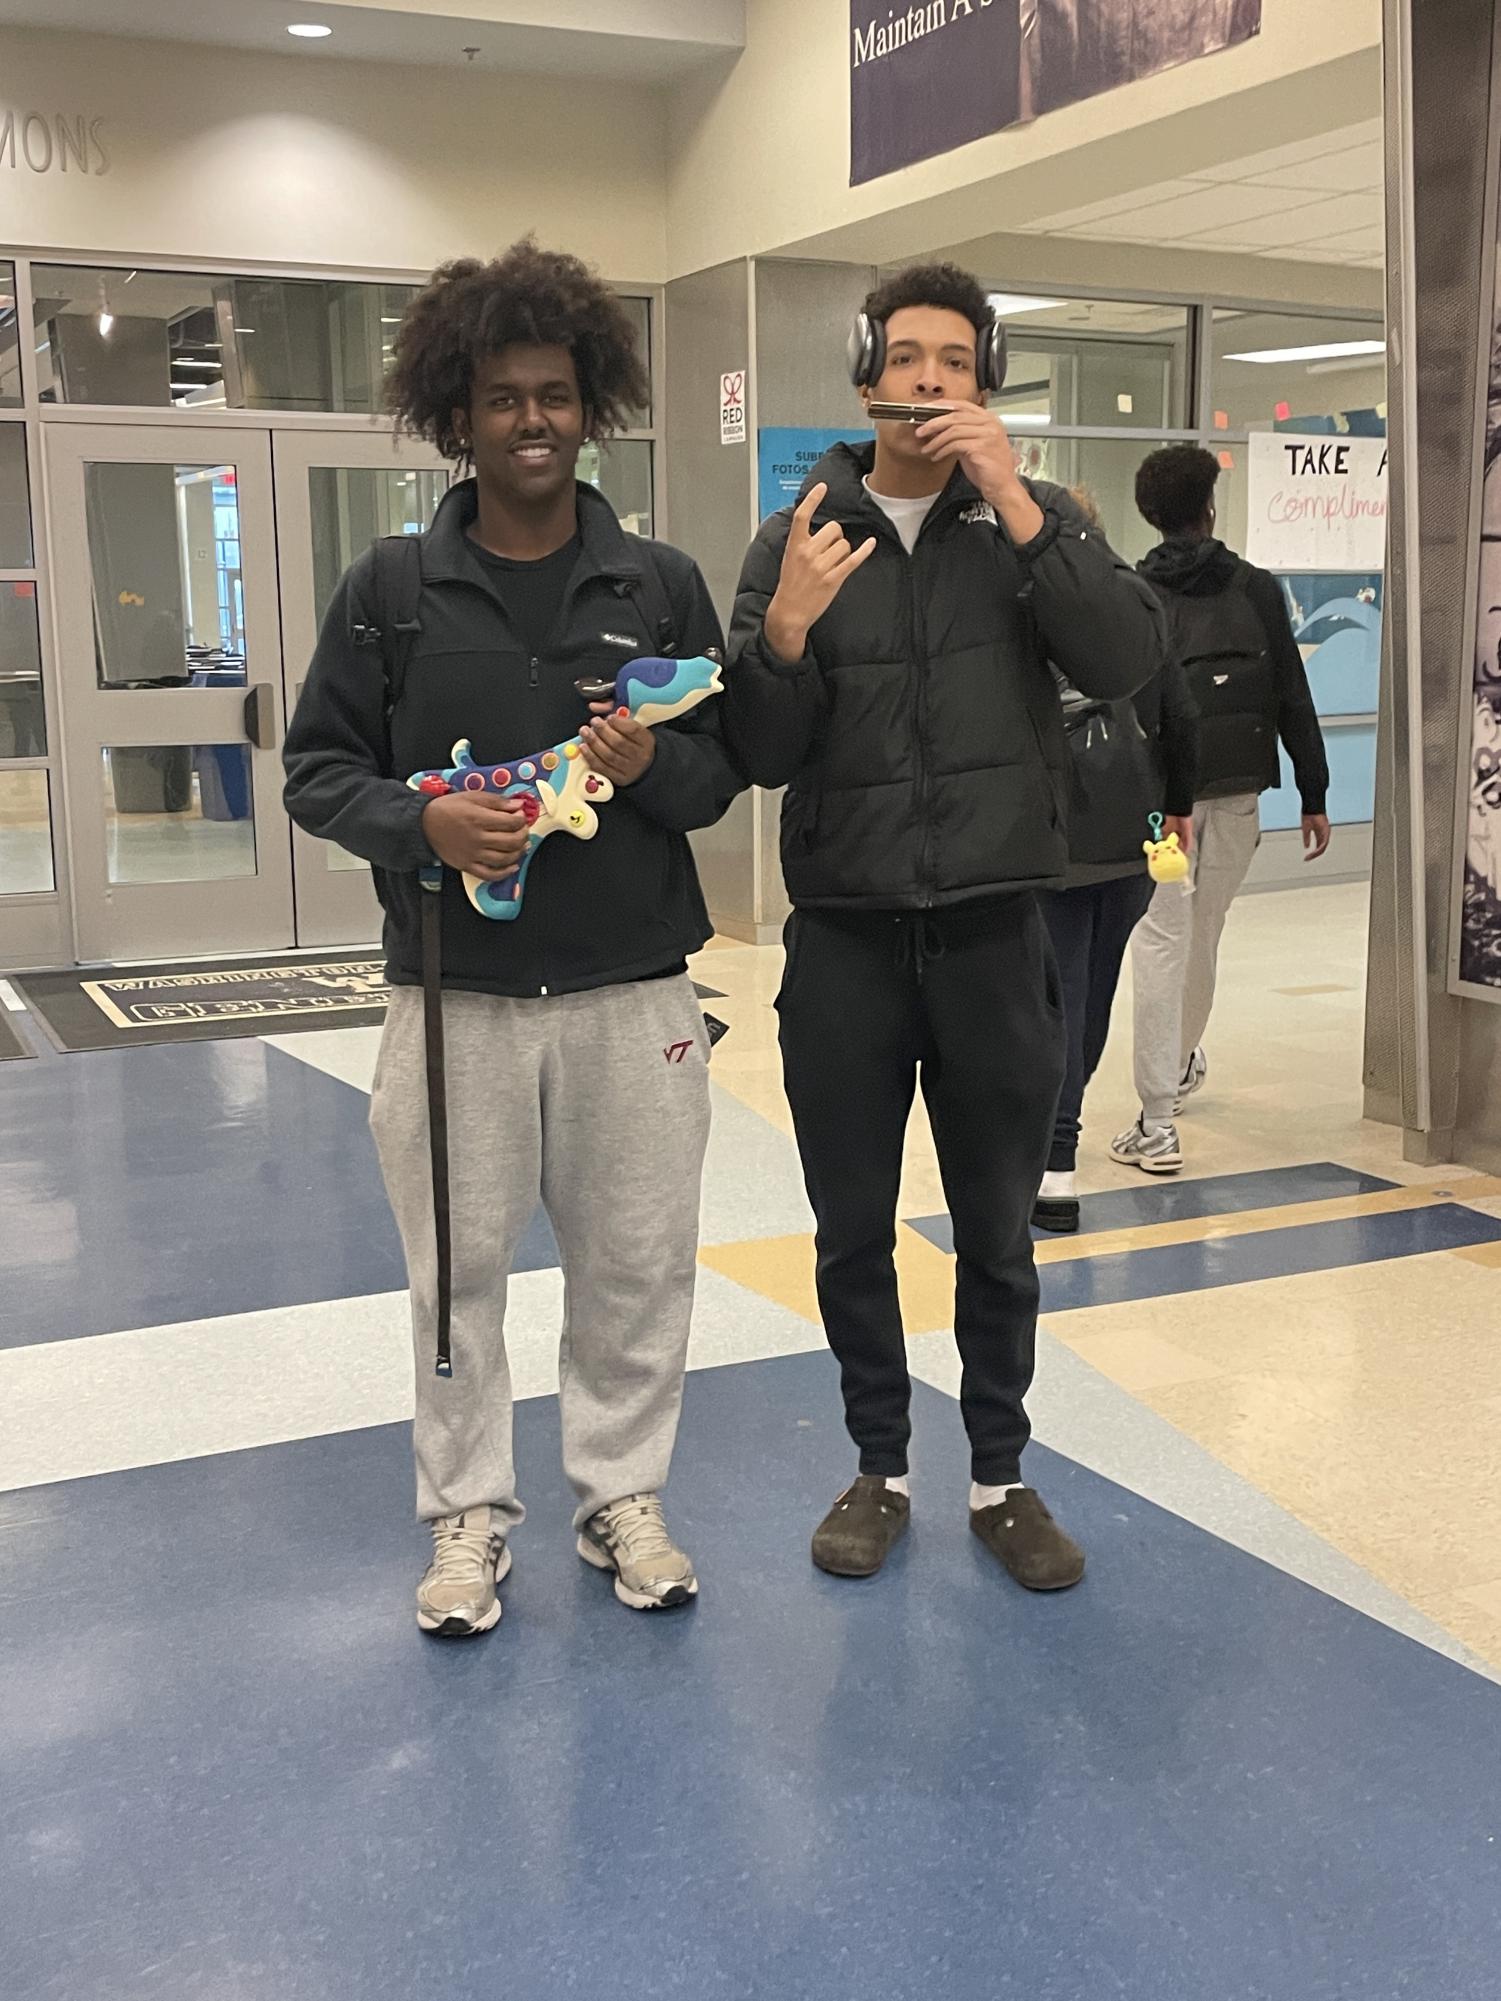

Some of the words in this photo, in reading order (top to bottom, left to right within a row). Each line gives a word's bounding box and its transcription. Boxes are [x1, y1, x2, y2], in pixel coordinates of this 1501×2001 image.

[853, 0, 946, 68] Maintain
[722, 407, 743, 425] RED
[772, 464, 808, 474] FOTOS
[1284, 444, 1350, 475] TAKE
[663, 1040, 694, 1064] VT
